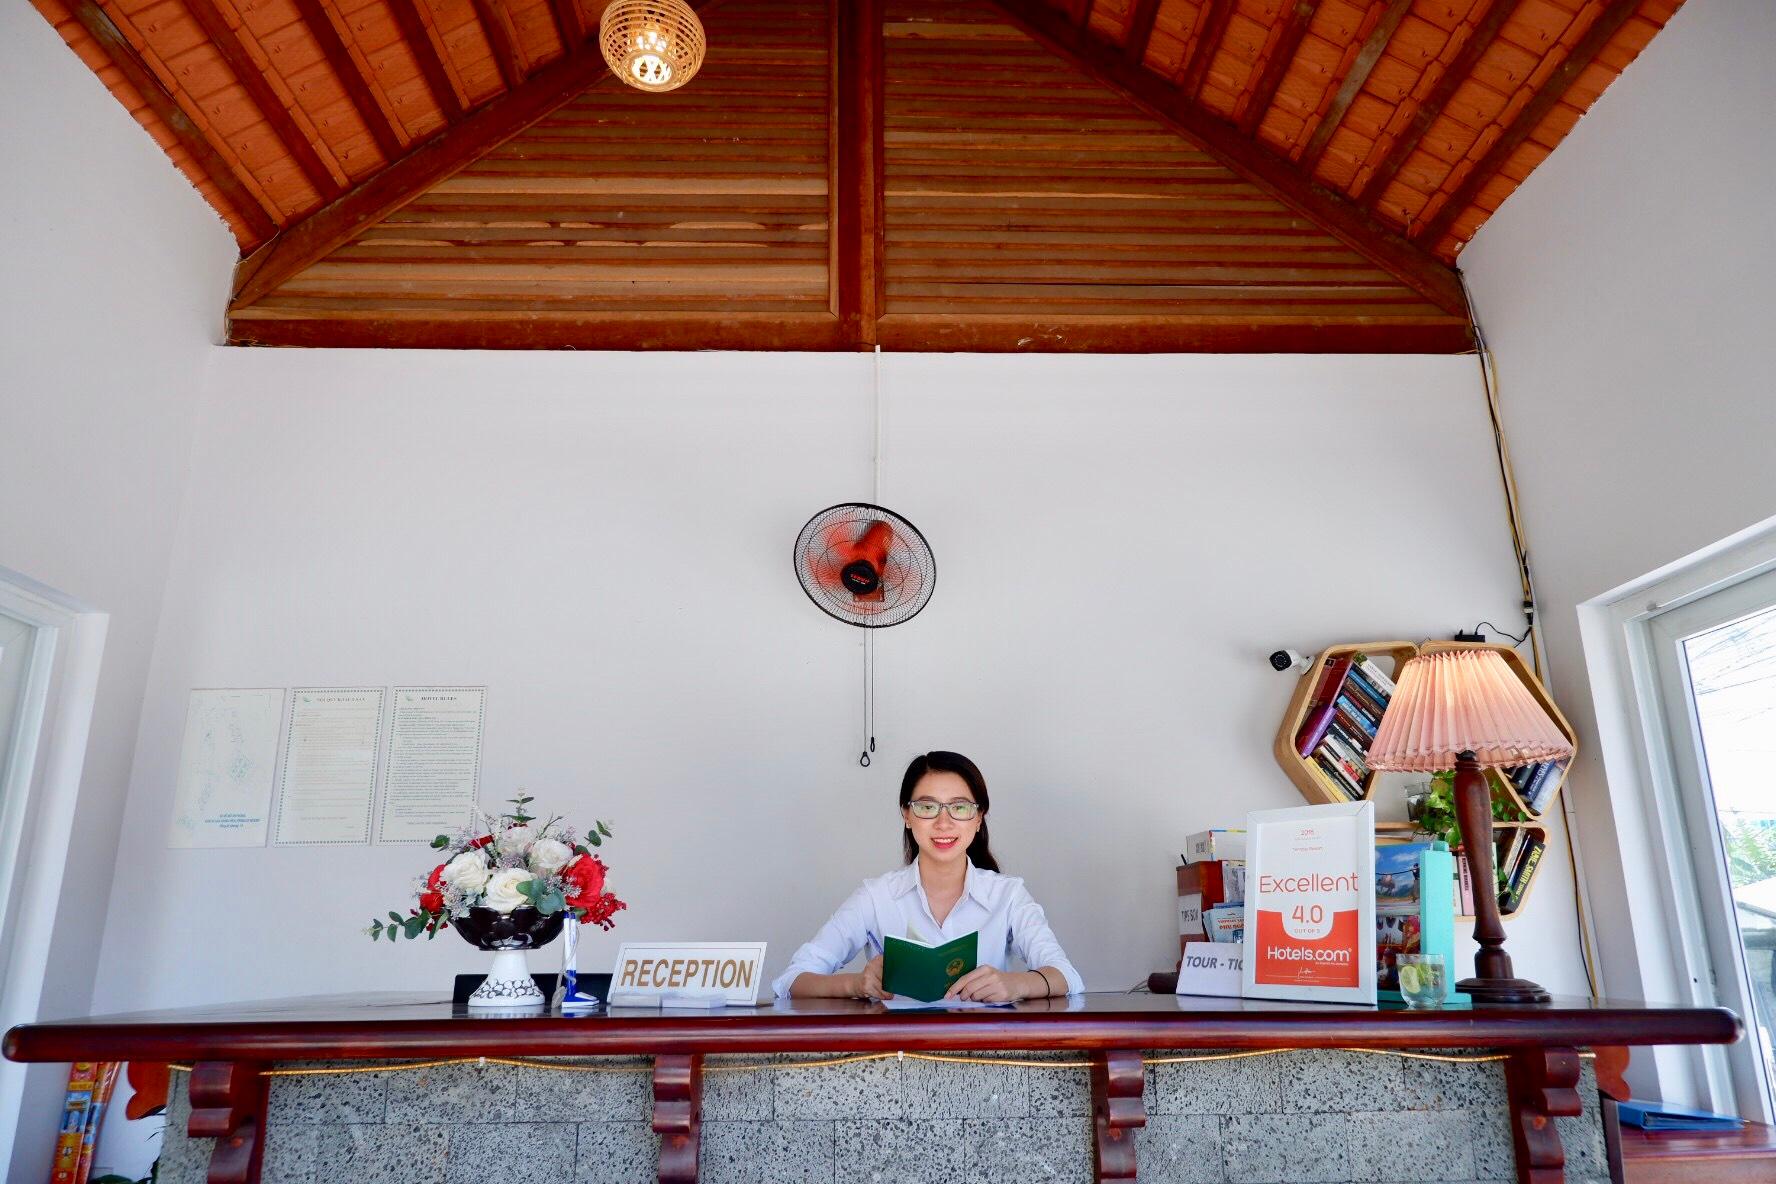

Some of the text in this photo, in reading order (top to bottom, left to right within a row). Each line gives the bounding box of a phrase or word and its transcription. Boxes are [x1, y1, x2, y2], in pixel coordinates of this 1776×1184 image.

[1259, 872, 1359, 893] Excellent
[1292, 905, 1323, 924] 4.0
[1186, 956, 1217, 969] TOUR
[1267, 946, 1350, 962] Hotels.com
[620, 958, 754, 989] RECEPTION
